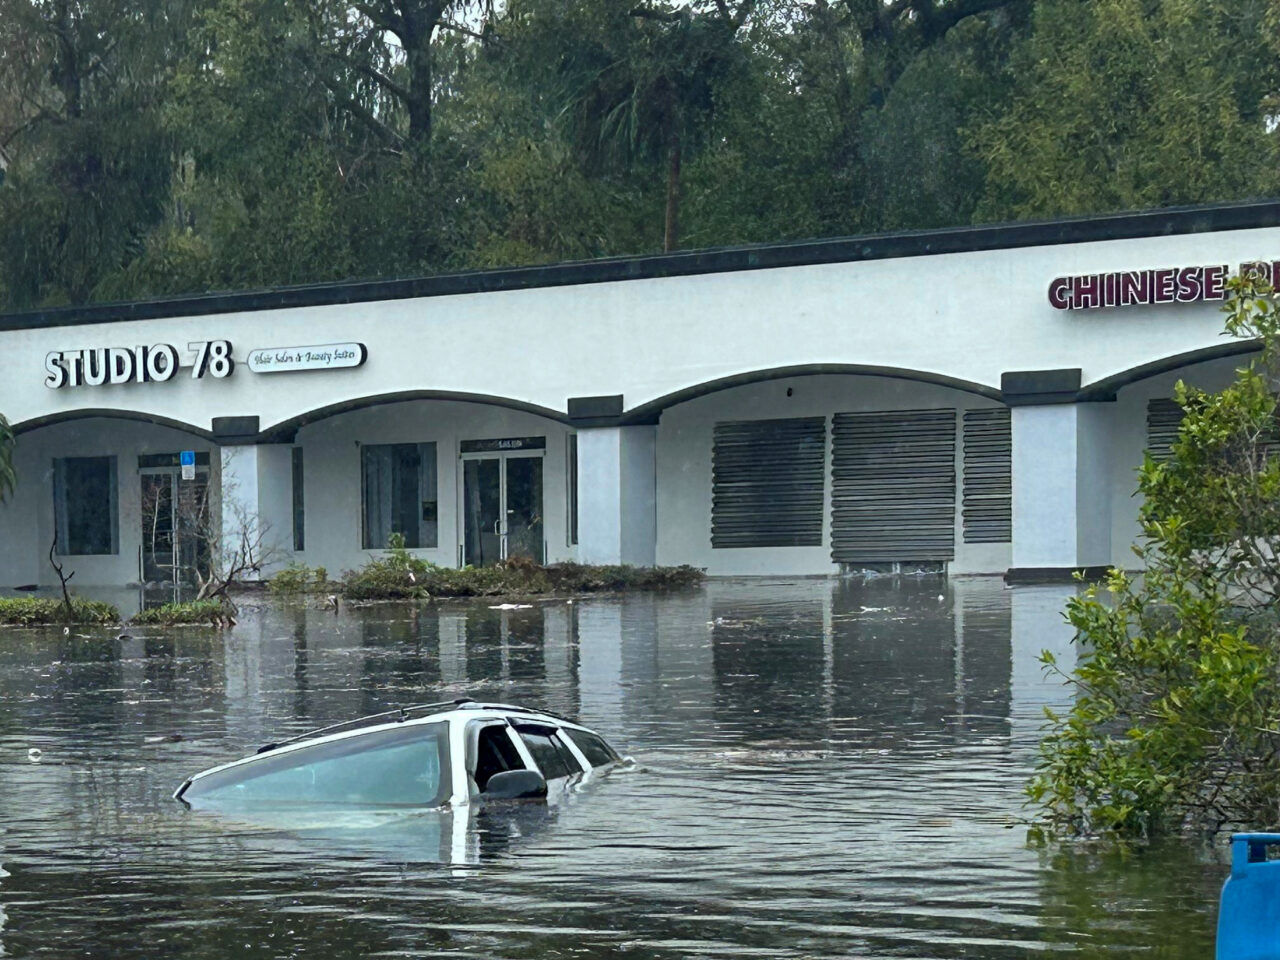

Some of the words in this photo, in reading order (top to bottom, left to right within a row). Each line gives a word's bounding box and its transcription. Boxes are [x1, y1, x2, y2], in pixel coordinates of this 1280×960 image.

[1048, 265, 1228, 310] CHINESE
[45, 343, 179, 389] STUDIO
[187, 339, 234, 378] 78
